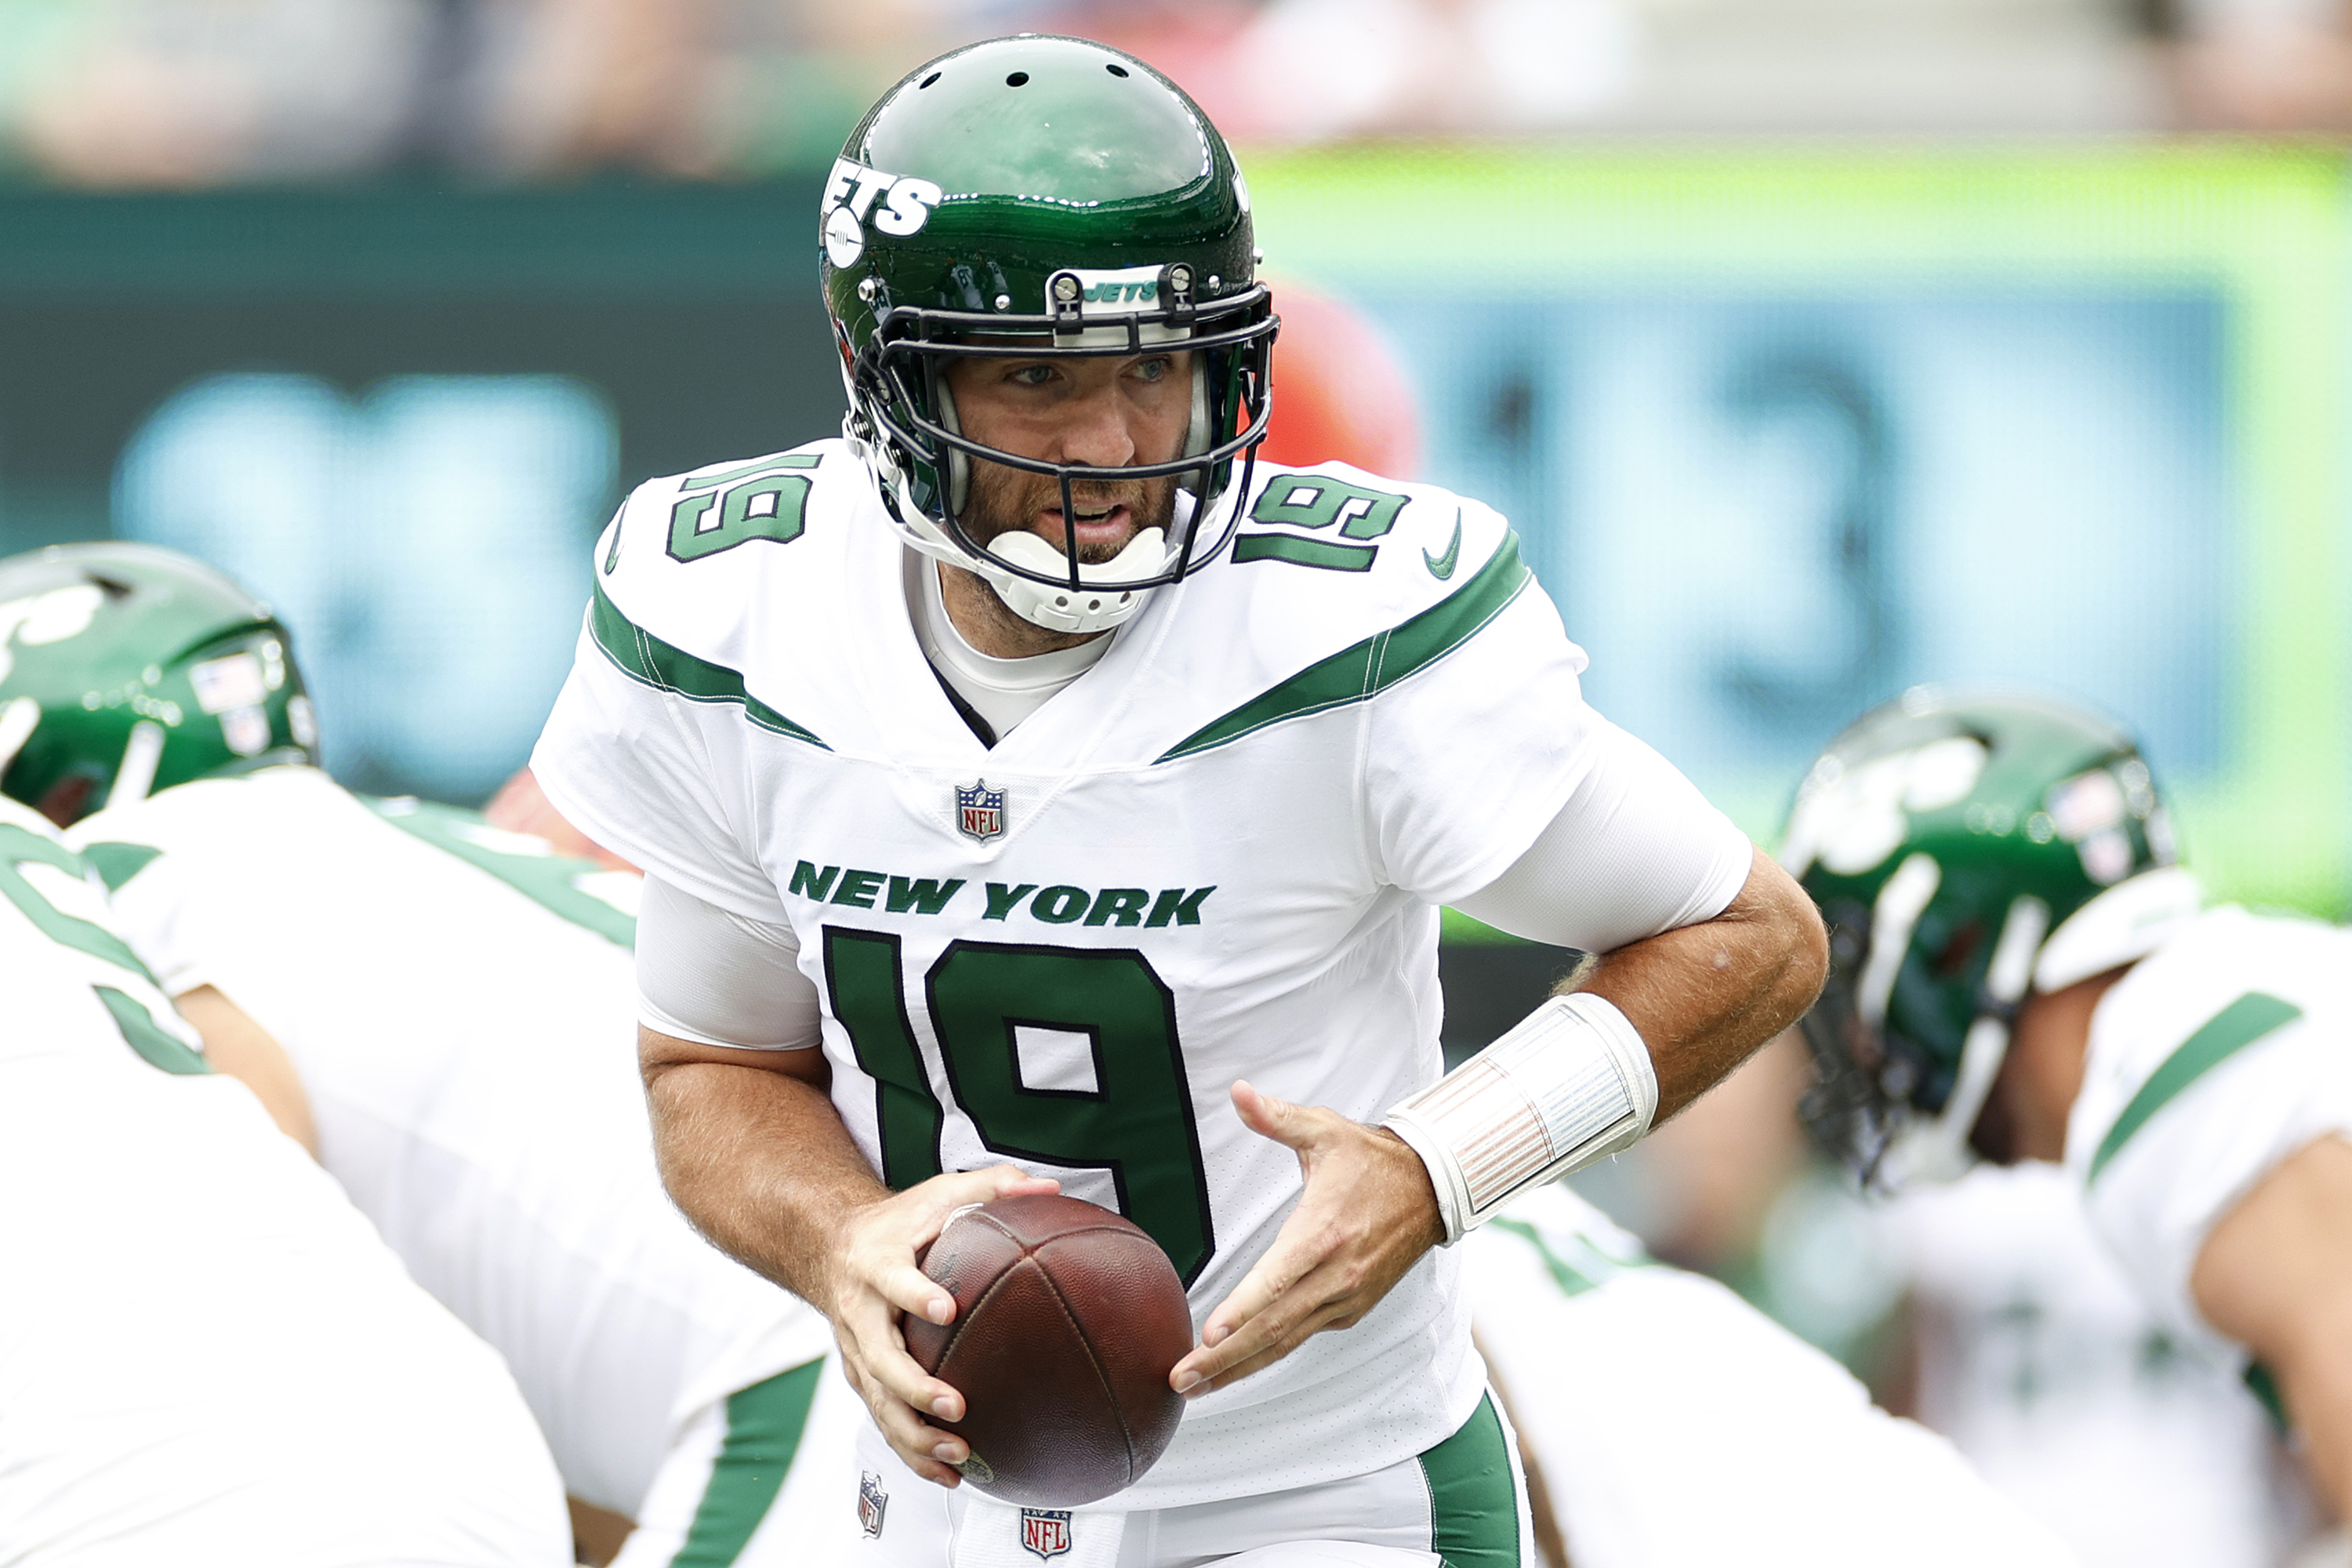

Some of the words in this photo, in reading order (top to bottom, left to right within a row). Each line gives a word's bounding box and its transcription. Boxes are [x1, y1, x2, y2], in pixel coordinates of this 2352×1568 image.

[1083, 280, 1159, 302] JETS
[665, 452, 825, 564] 19
[1229, 473, 1413, 572] 19
[962, 808, 1000, 834] NFL
[787, 858, 967, 916] NEW
[981, 881, 1218, 929] YORK
[822, 924, 1216, 1294] 19
[858, 1495, 878, 1531] NFL
[1024, 1519, 1067, 1553] NFL
